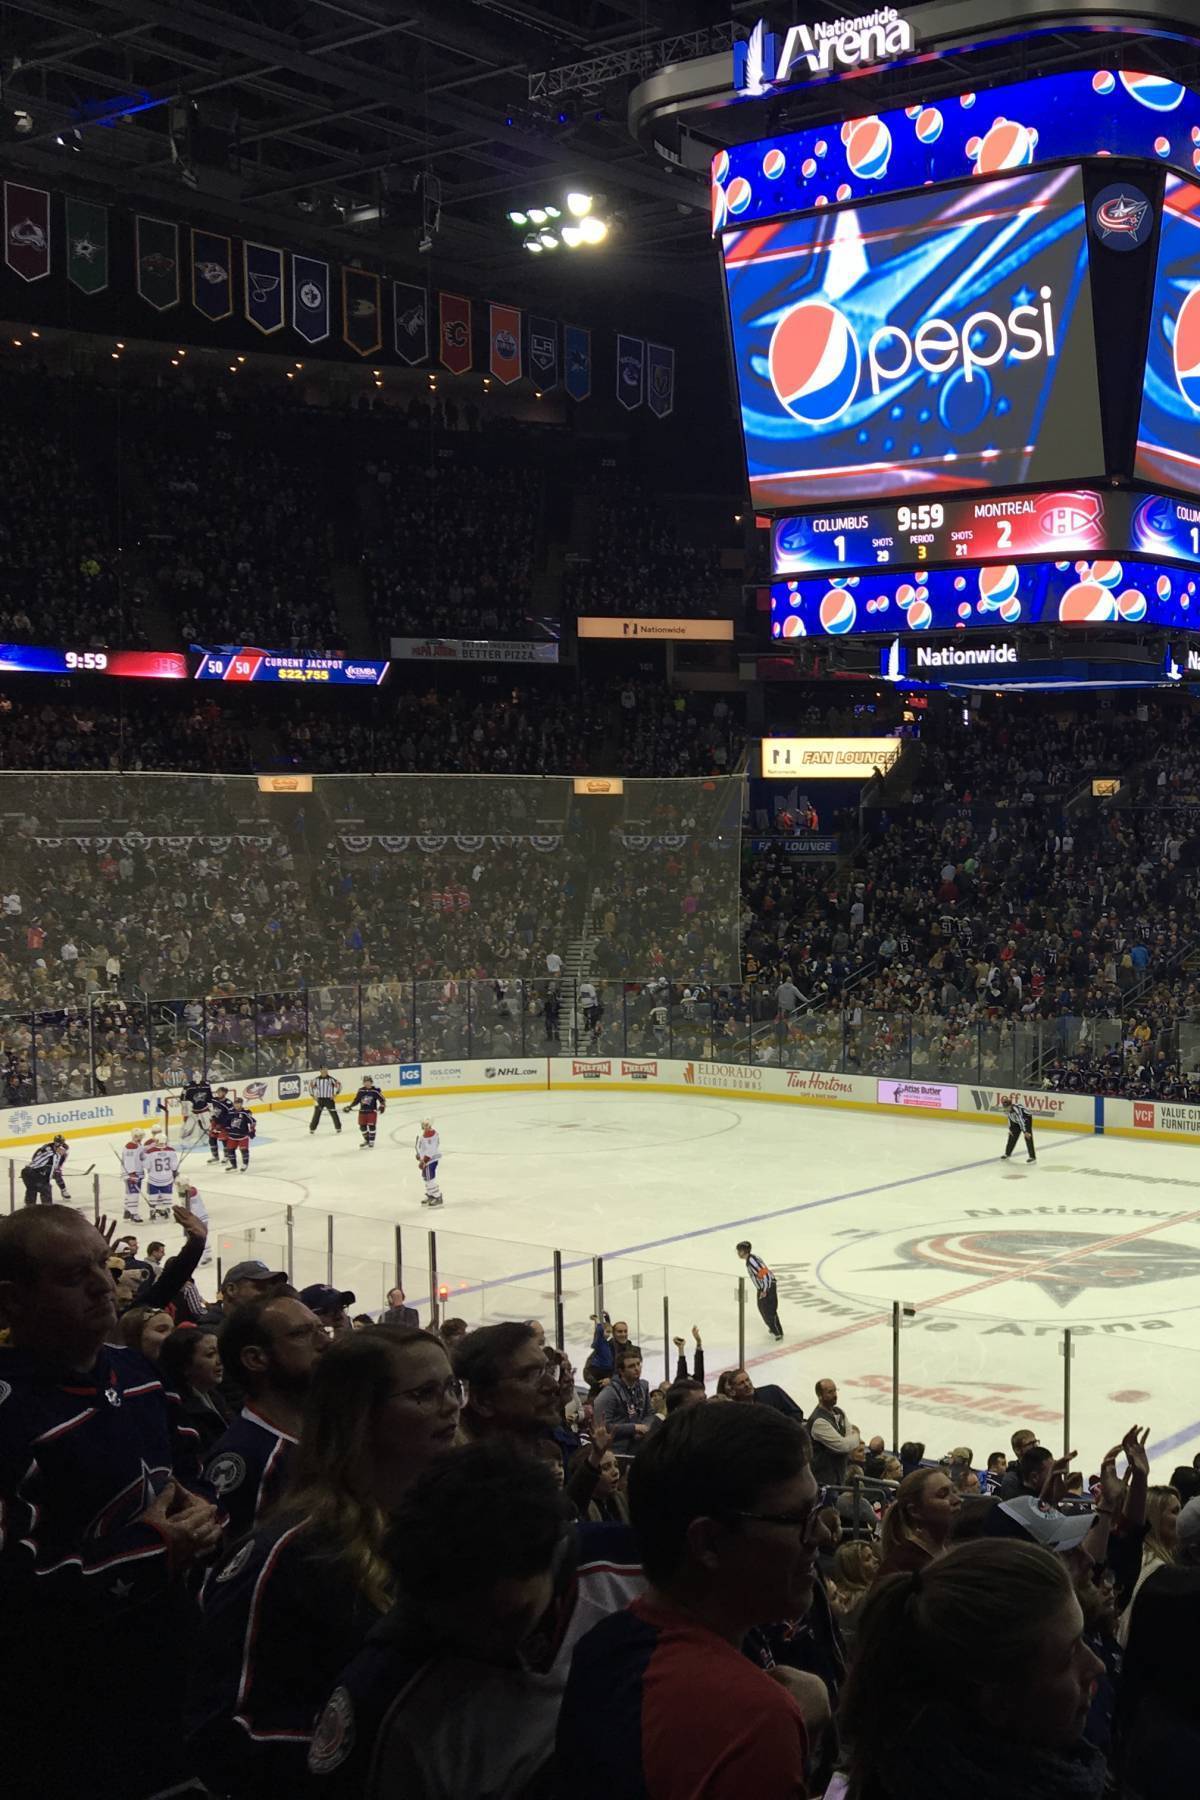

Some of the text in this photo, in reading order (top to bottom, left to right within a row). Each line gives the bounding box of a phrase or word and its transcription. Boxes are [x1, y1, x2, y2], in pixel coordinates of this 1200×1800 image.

[814, 6, 898, 40] Nationwide
[775, 18, 911, 81] Arena
[868, 285, 1055, 395] pepsi
[974, 501, 1037, 518] MONTREAL
[813, 516, 869, 533] COLUMBUS
[897, 503, 944, 532] 9:59
[909, 534, 934, 545] PERIOD
[951, 531, 973, 542] SHOTS
[996, 520, 1012, 549] 2
[1190, 527, 1199, 554] 1
[833, 536, 846, 562] 1
[872, 537, 894, 549] SHOTS
[956, 544, 968, 556] 21
[877, 551, 889, 562] 29
[918, 546, 927, 560] 3
[640, 625, 686, 634] Nationwide
[65, 652, 107, 670] 9:59
[462, 649, 536, 659] BETTER PIZZA
[916, 647, 1017, 668] Nationwide
[208, 660, 223, 674] 50
[235, 661, 250, 674] 50
[265, 657, 343, 670] CURRENT JACKPOT
[278, 669, 329, 681] $22,755
[350, 668, 377, 677] KEMBA
[802, 751, 832, 764] FAN
[785, 842, 831, 851] LOUNGE
[401, 1070, 420, 1080] IGS
[696, 1063, 762, 1080] ELDORADO
[280, 1080, 298, 1091] FOX
[787, 1071, 852, 1092] Tim Hortons
[996, 1092, 1021, 1108] Jeff
[1023, 1095, 1064, 1112] Wyler
[36, 1104, 114, 1128] OhioHealth
[1135, 1110, 1153, 1122] VCF
[1161, 1106, 1186, 1119] VALUE
[151, 1156, 168, 1170] 63
[980, 1319, 1175, 1338] Arena
[841, 1373, 1066, 1422] Safelite
